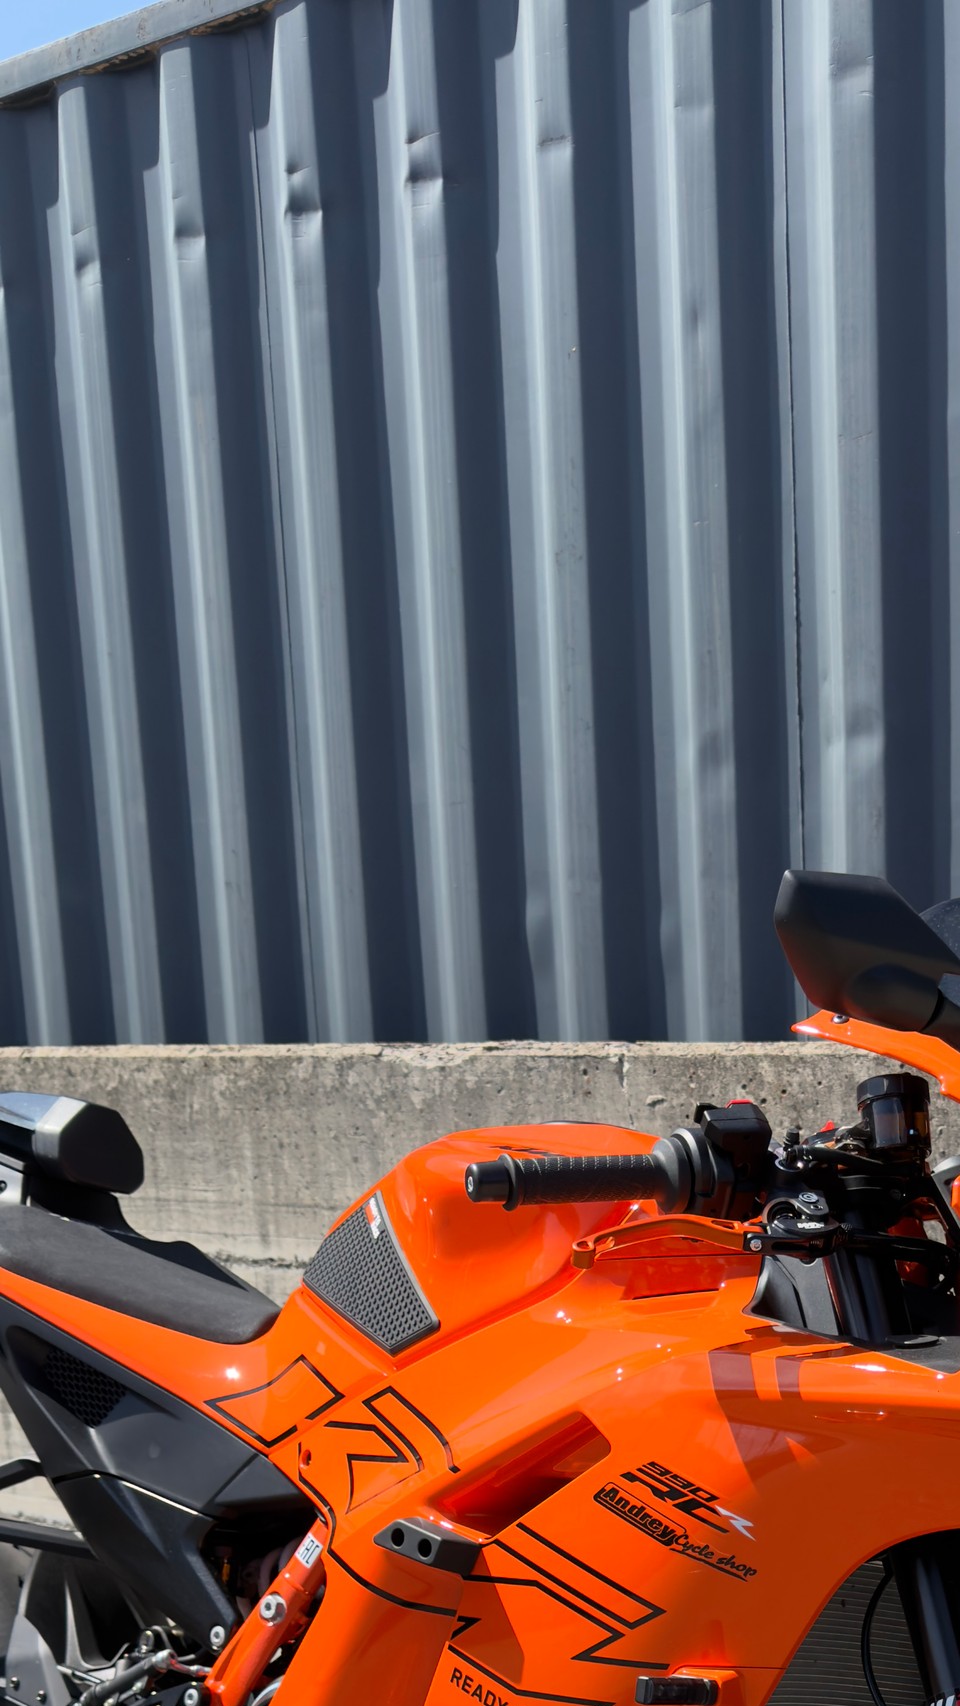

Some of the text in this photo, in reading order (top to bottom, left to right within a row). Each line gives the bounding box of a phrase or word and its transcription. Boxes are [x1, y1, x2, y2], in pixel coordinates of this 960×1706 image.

[641, 1461, 721, 1503] 990
[601, 1486, 758, 1578] Andrey Cycle shop
